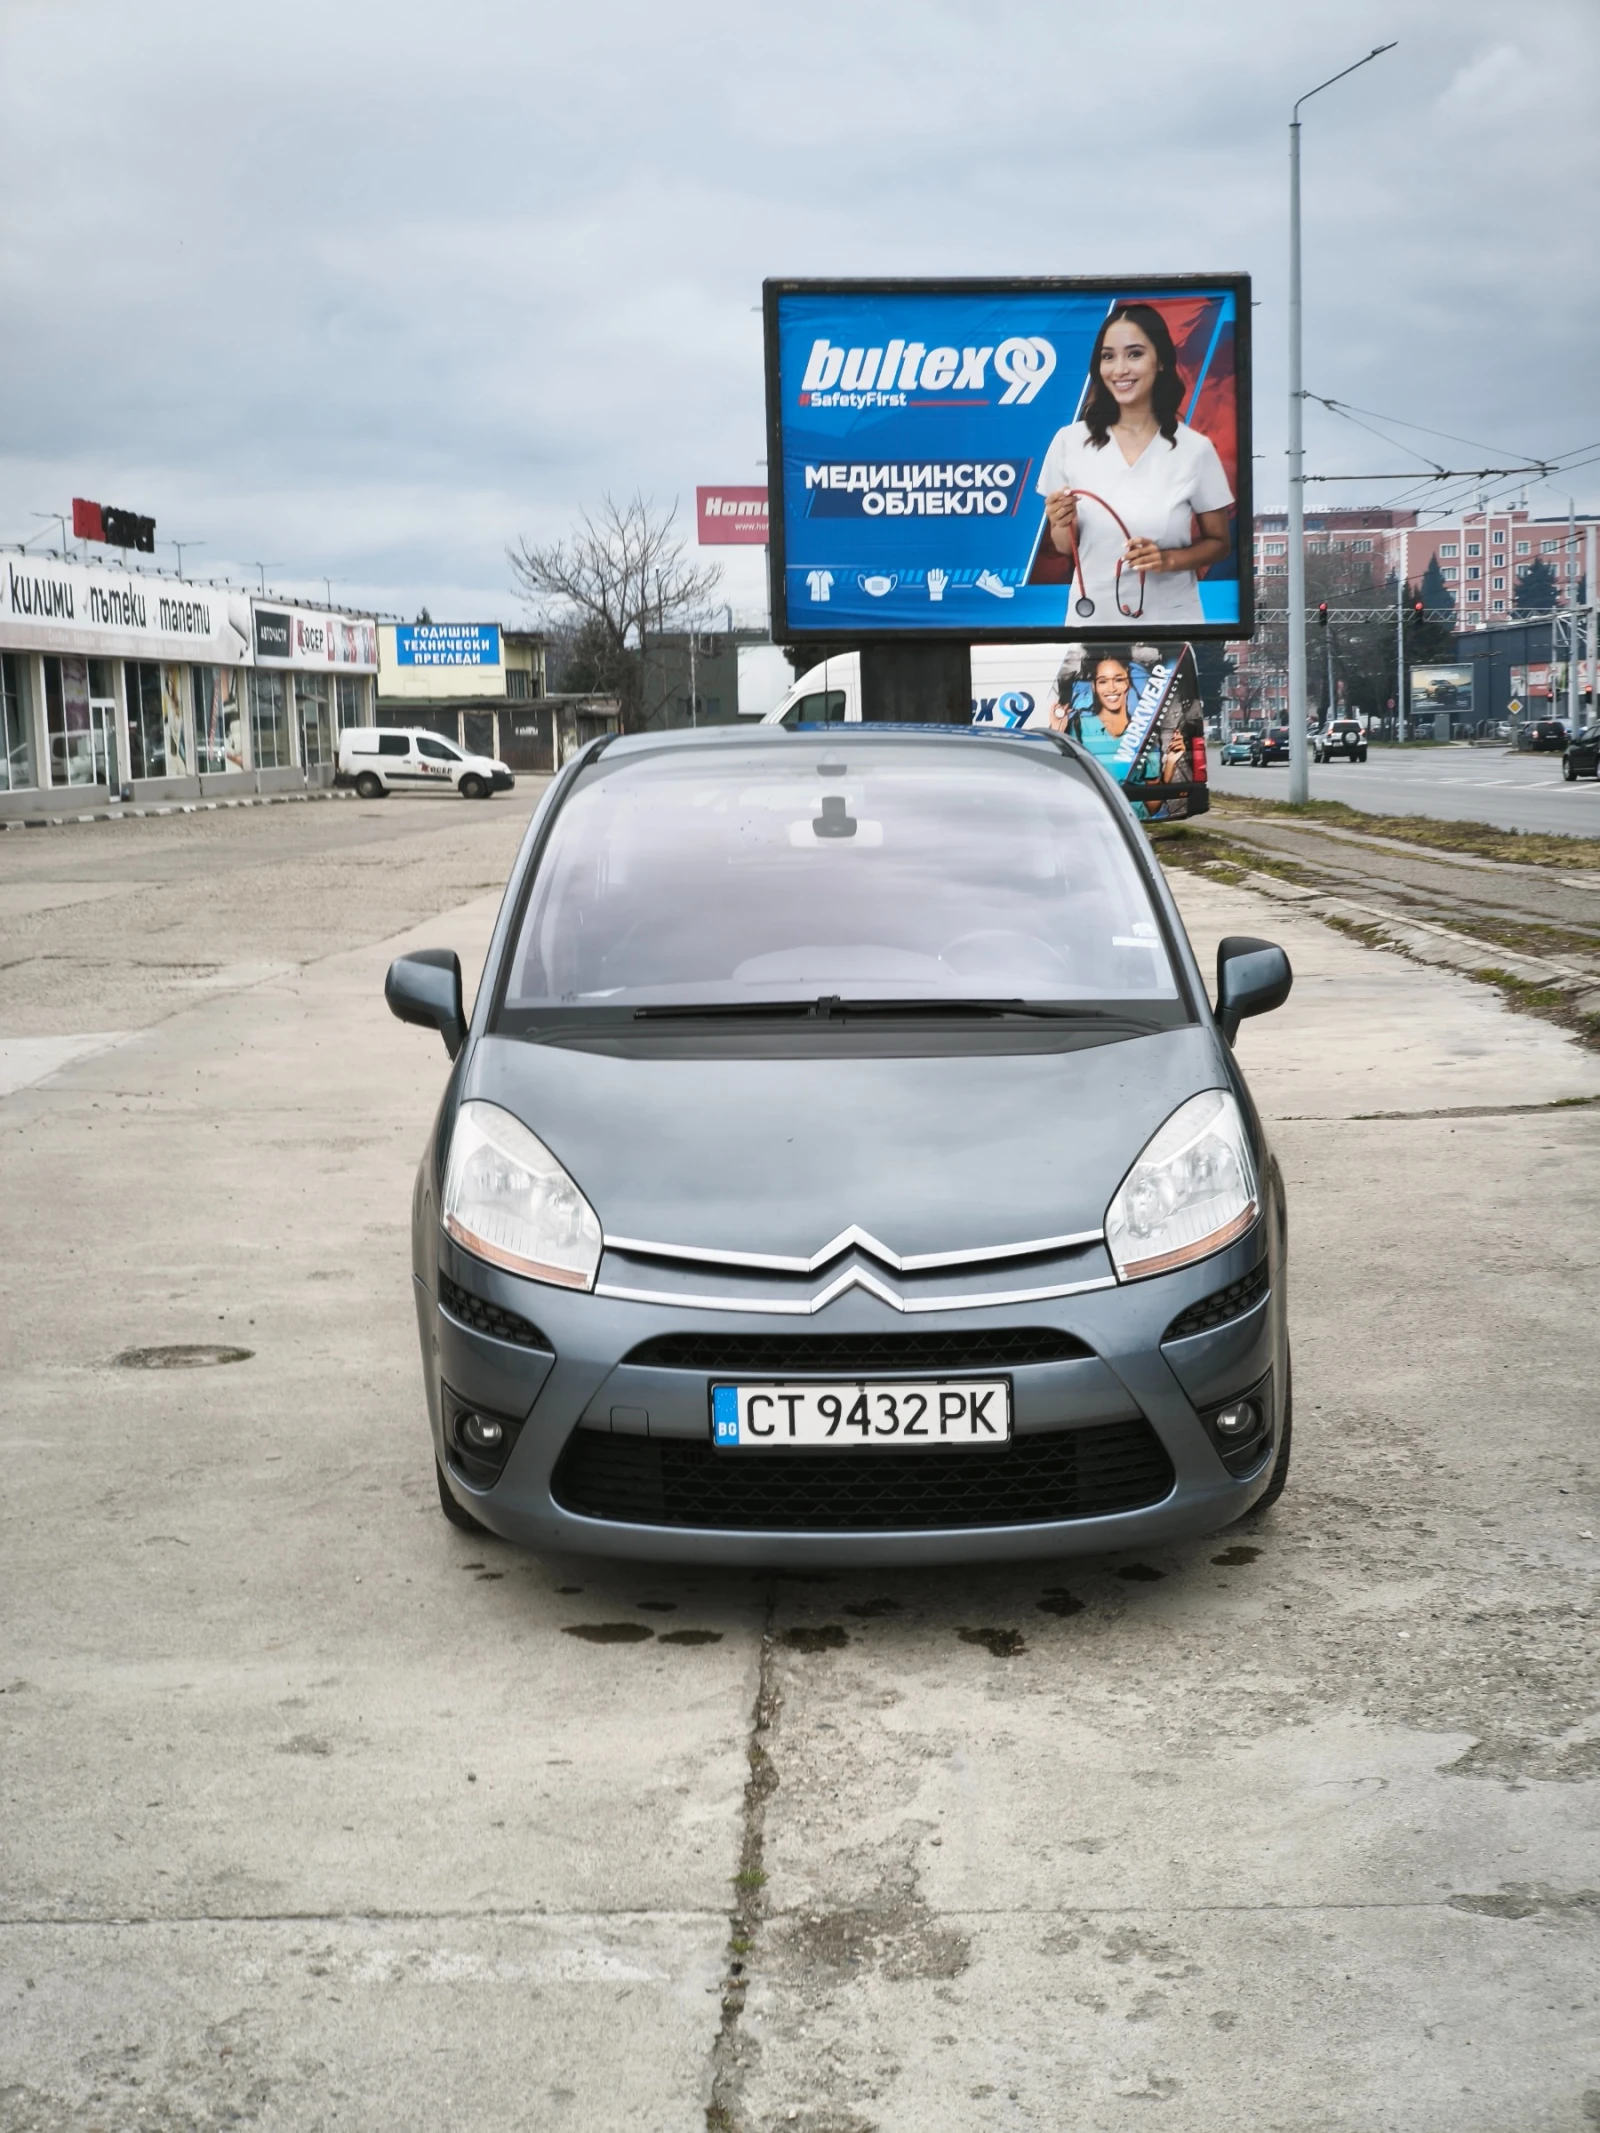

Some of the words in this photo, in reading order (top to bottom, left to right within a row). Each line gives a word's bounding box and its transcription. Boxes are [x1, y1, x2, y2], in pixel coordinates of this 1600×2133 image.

[799, 391, 907, 409] #SafetyFirst
[805, 464, 1016, 492] МЕДИЦИНСКО
[862, 491, 1008, 515] ОБЛЕКЛО
[1302, 503, 1330, 514] OTEL
[9, 562, 74, 620] килими
[90, 582, 147, 629] пътеки
[159, 597, 211, 635] тапети
[413, 626, 479, 639] ГОДИШНИ
[403, 639, 490, 651] ТЕХНИЧЕСКИ
[414, 652, 481, 665] ПРЕГЛЕДИ
[1156, 673, 1182, 726] PRODUCTS
[1113, 664, 1173, 763] WORKWEAR
[747, 1394, 805, 1437] CT
[817, 1393, 929, 1436] 9432
[939, 1391, 998, 1435] PK
[718, 1422, 737, 1437] BG
